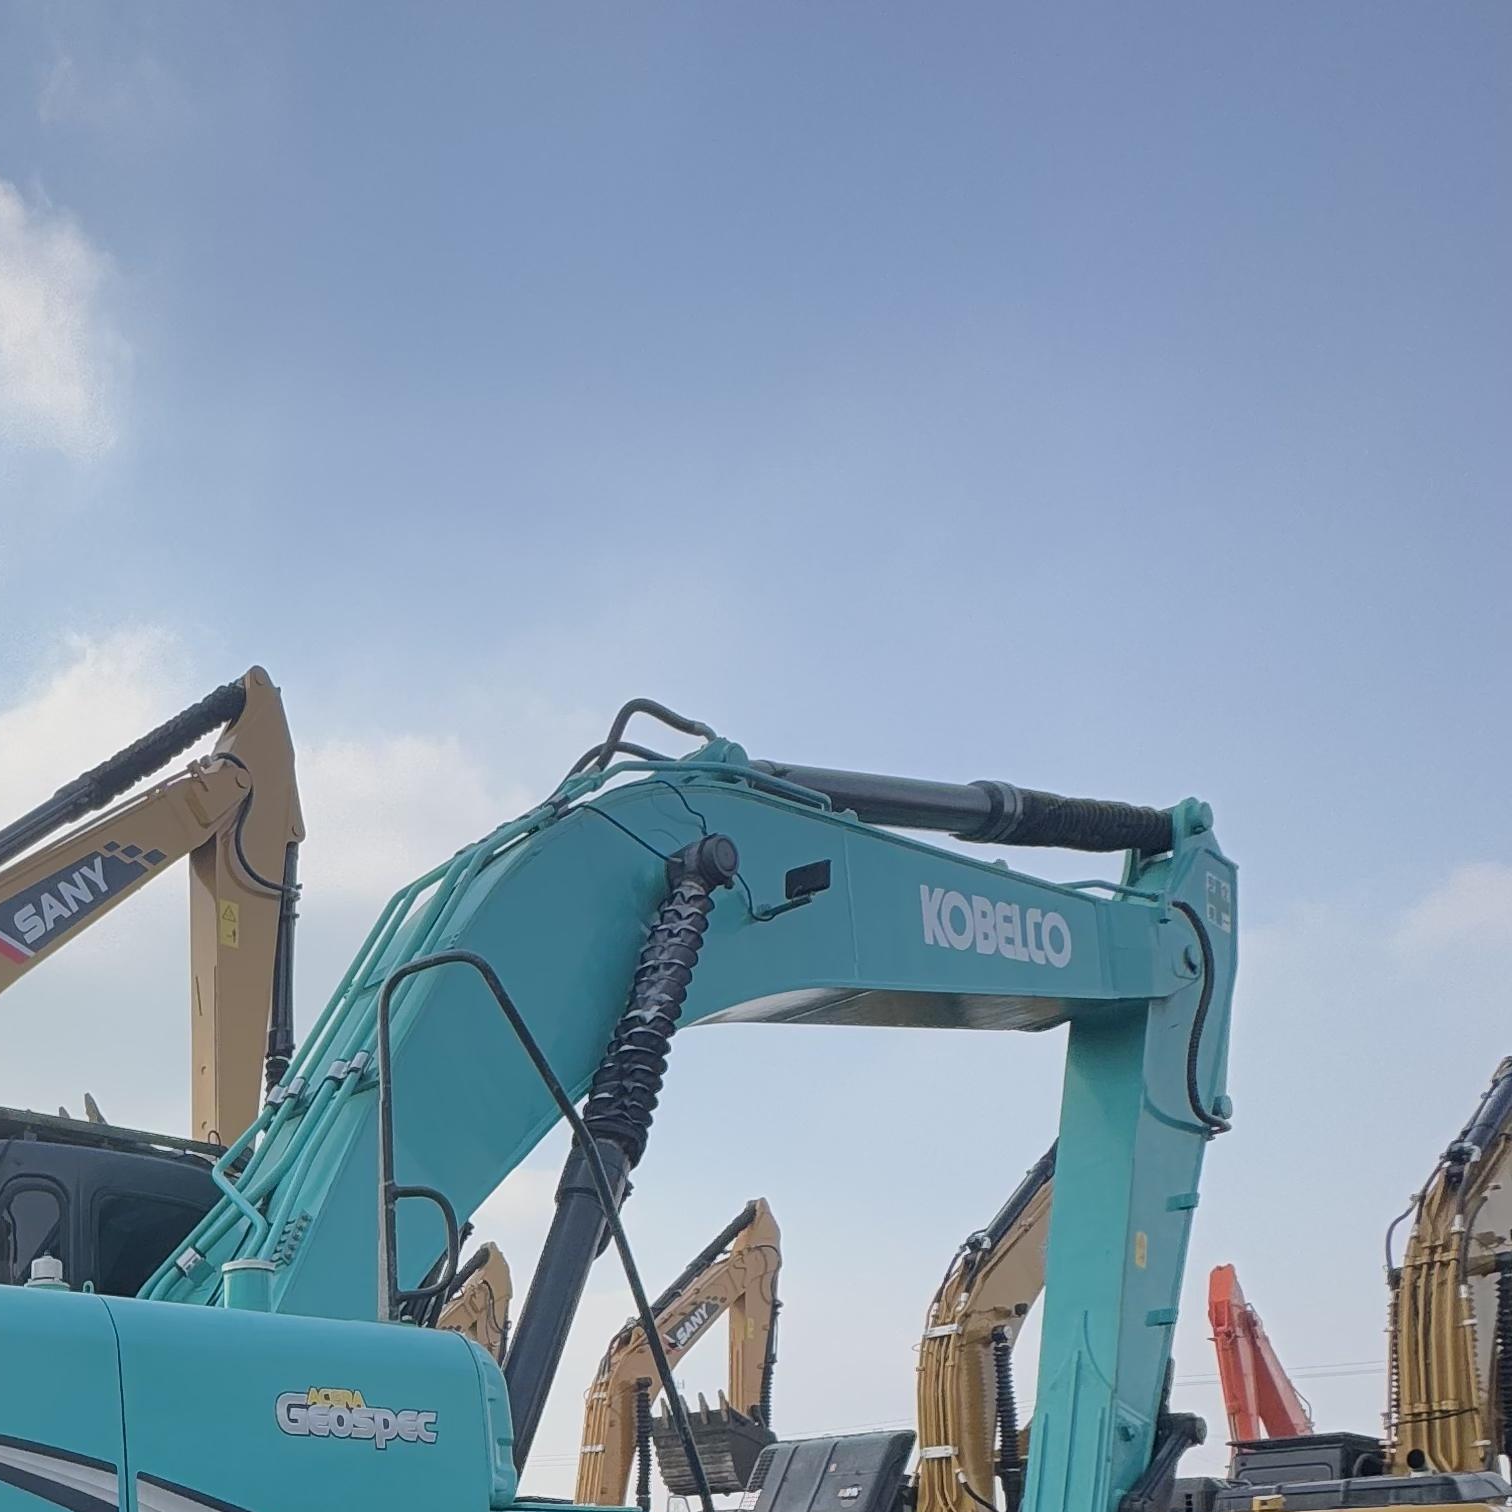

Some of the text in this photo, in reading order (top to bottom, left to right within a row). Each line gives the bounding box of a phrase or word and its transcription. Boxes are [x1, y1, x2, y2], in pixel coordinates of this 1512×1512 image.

[13, 855, 109, 945] SANY
[919, 884, 1072, 969] KOBELCO
[675, 1303, 709, 1346] SANY
[306, 1386, 366, 1409] ACERA
